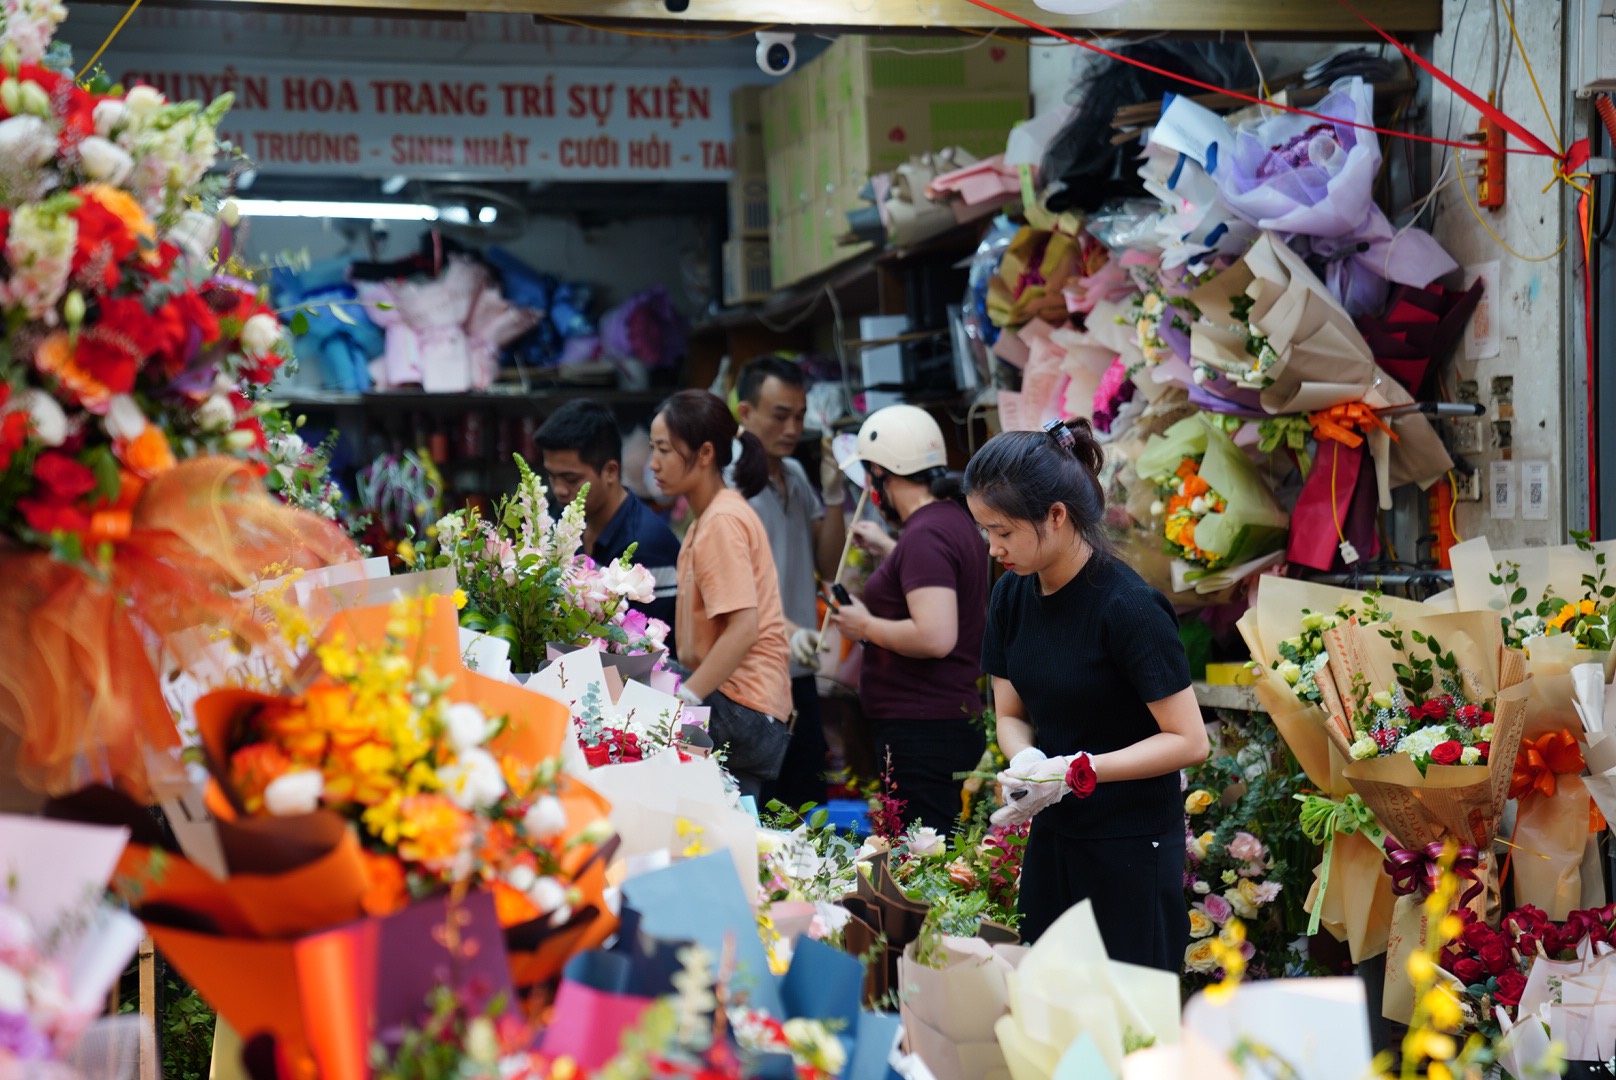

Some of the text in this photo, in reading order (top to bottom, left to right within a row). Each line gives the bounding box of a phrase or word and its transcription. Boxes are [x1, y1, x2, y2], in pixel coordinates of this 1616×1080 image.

[282, 77, 360, 113] HOA
[369, 79, 488, 116] TRANG
[498, 74, 555, 117] TRÍ
[567, 82, 616, 127] SỰ
[626, 76, 710, 128] KIỆN
[391, 133, 454, 166] SINH
[463, 131, 529, 172] NHẬT
[629, 131, 672, 169] HỎI
